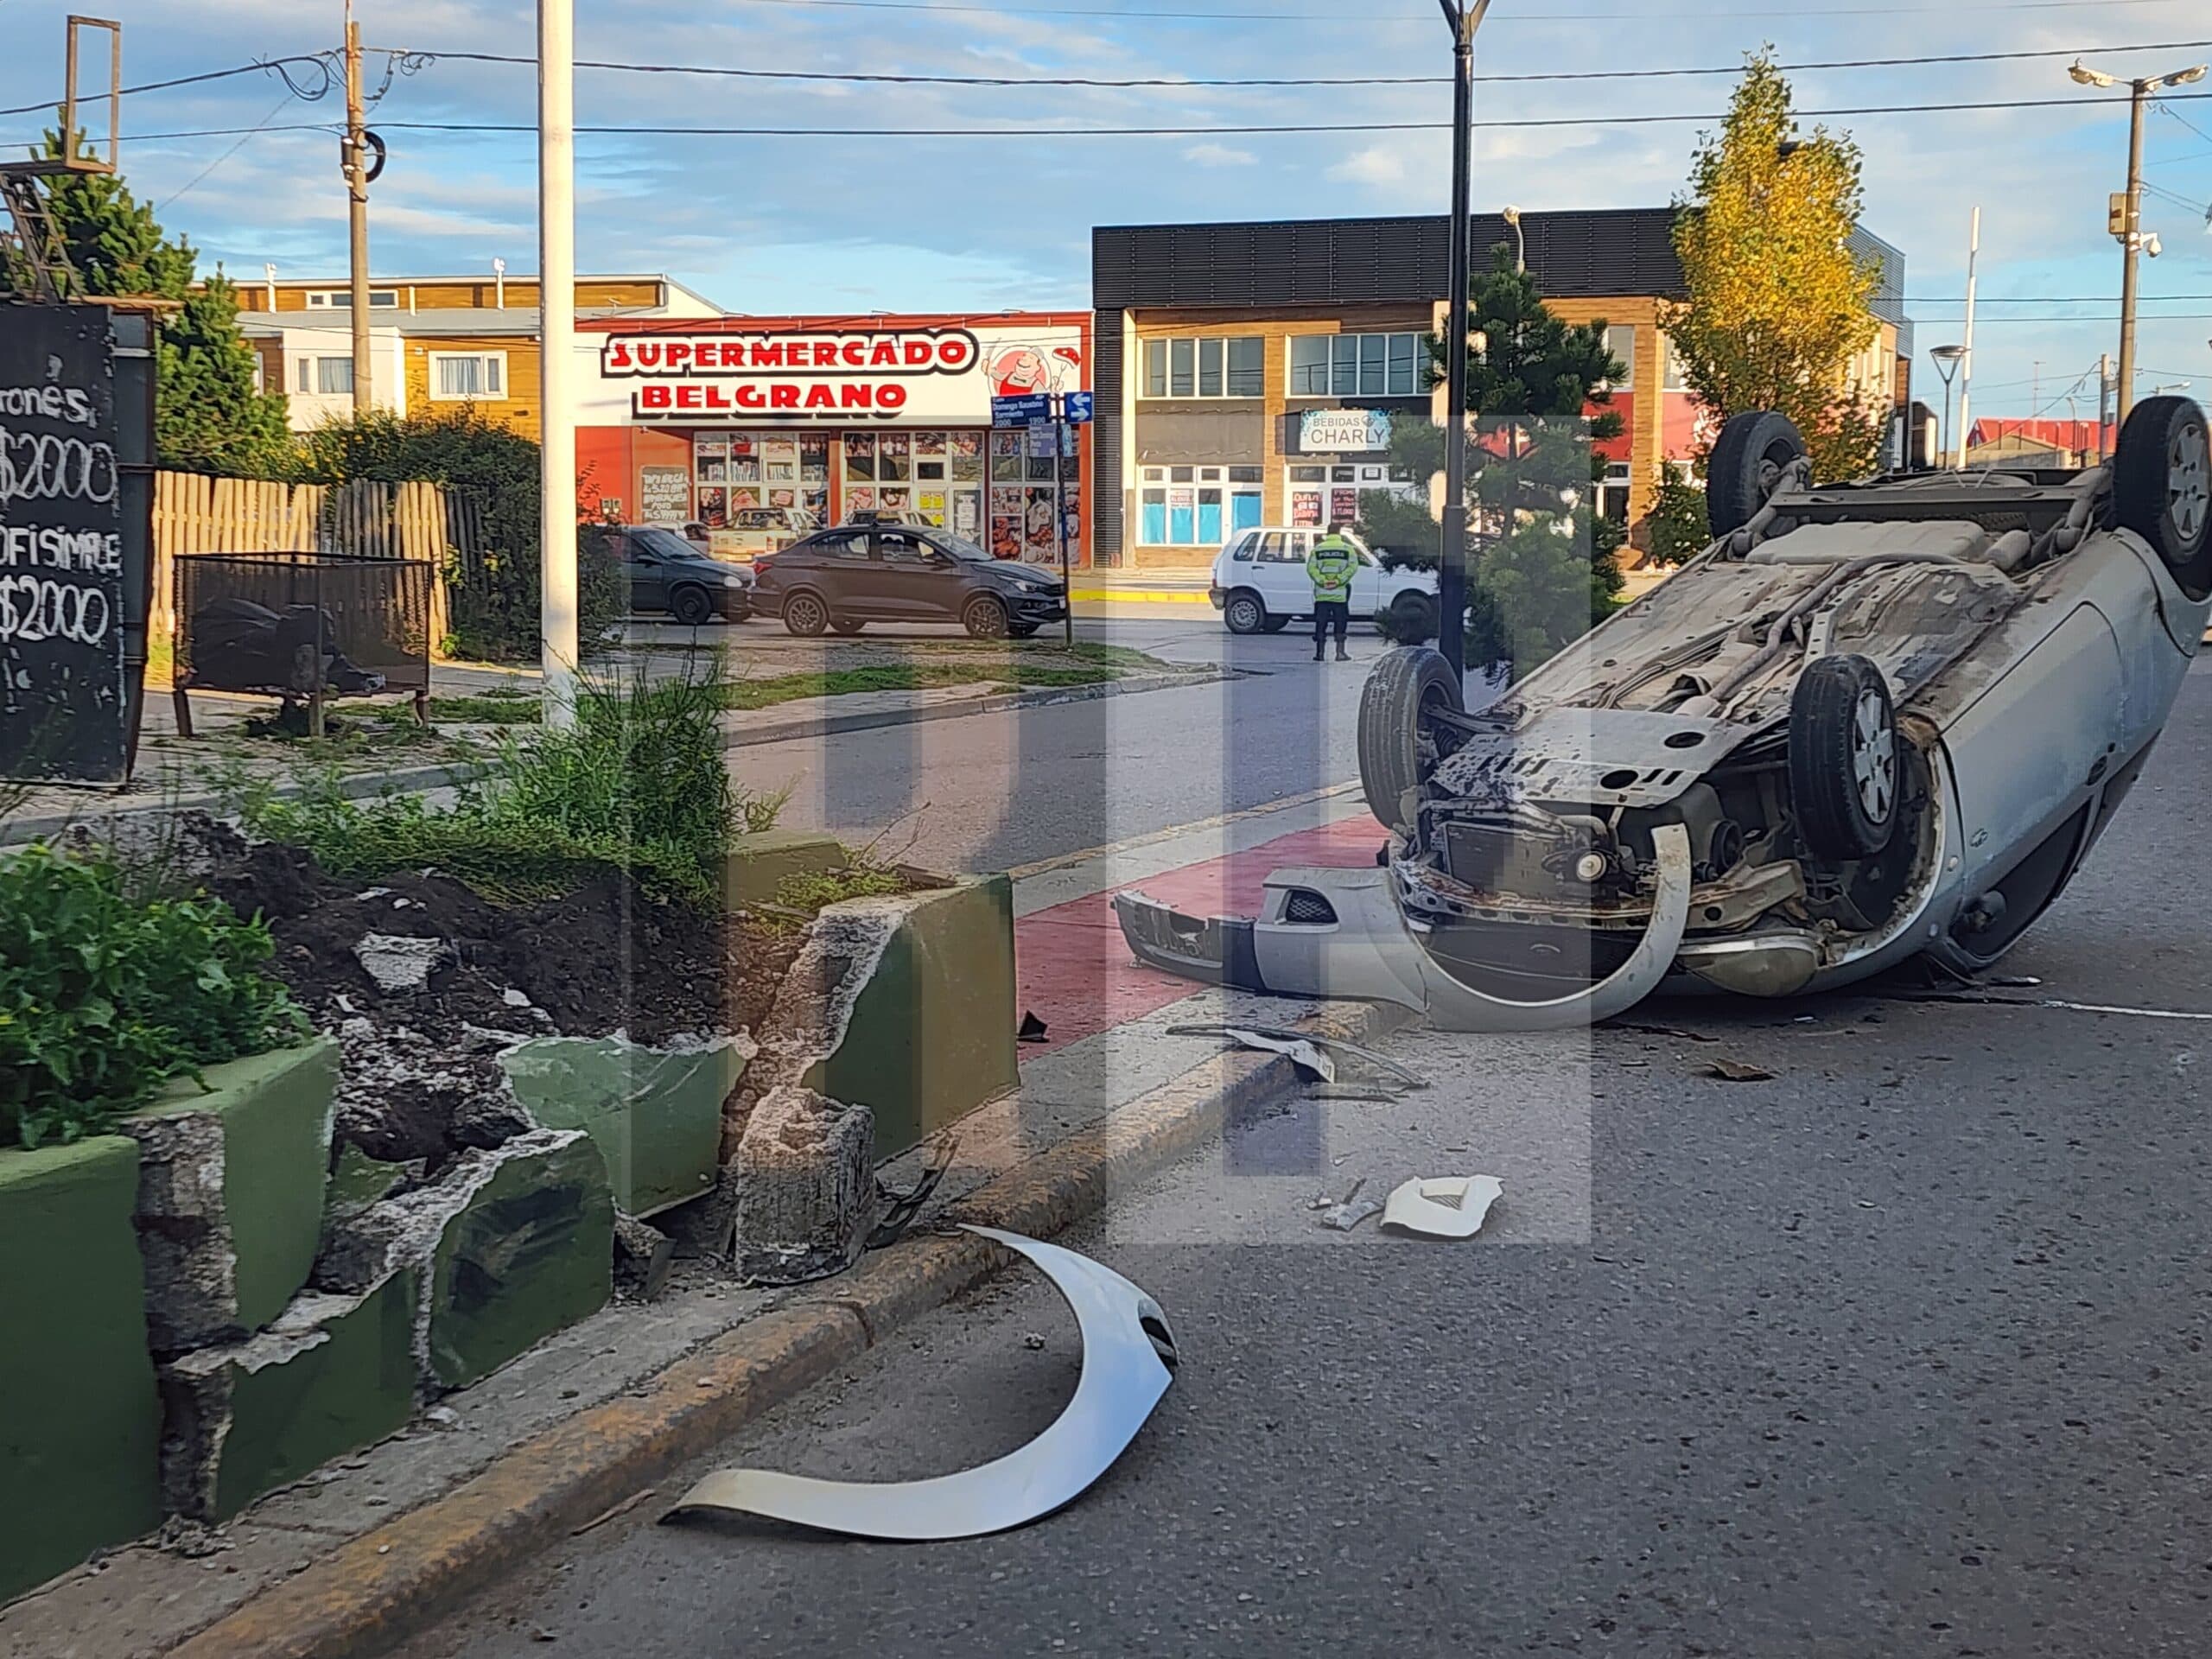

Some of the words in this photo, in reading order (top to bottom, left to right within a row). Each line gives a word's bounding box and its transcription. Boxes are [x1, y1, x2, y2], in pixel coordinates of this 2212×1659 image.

[610, 340, 967, 367] SUPERMERCADO
[642, 384, 907, 409] BELGRANO
[1313, 417, 1360, 427] BEBIDAS
[1311, 429, 1385, 444] CHARLY
[0, 424, 118, 503] $2000
[0, 575, 109, 645] $2000
